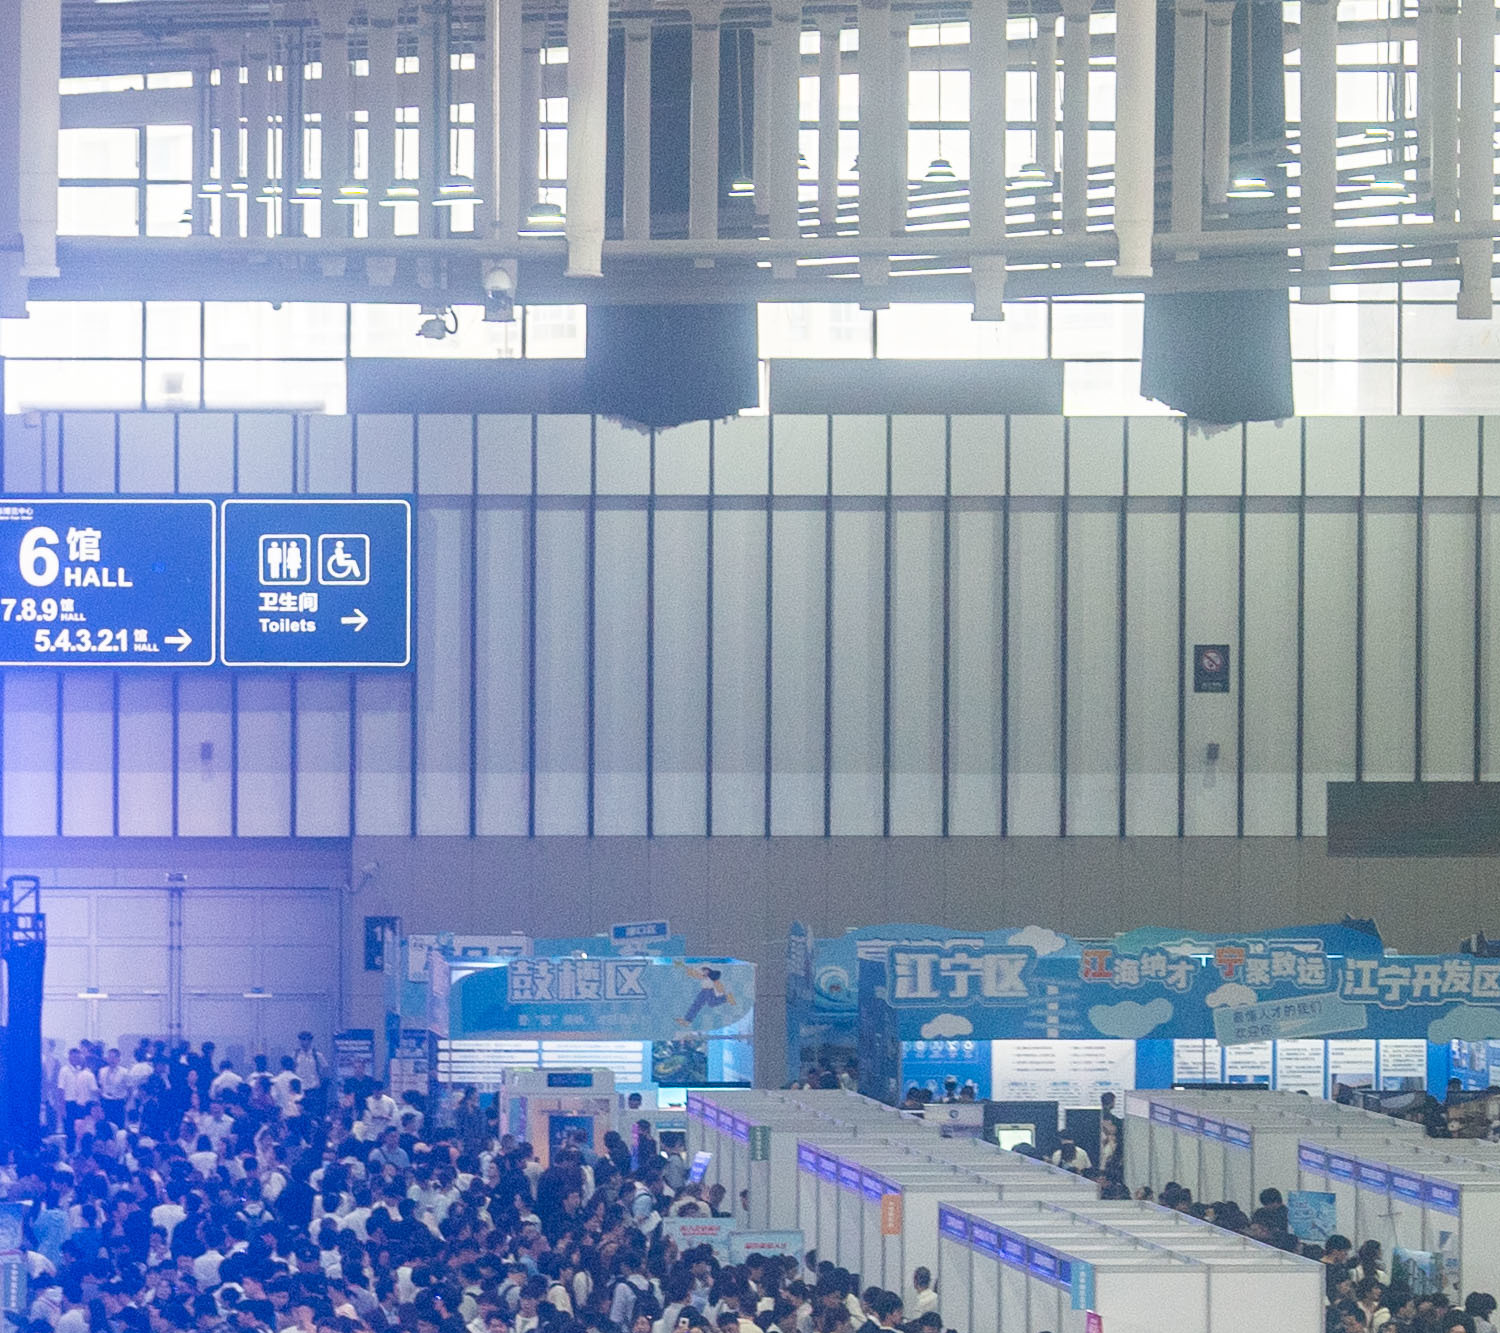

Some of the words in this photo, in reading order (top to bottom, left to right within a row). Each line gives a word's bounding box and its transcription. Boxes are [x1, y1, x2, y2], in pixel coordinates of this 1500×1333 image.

[19, 526, 60, 588] 6
[66, 527, 102, 562] 馆
[64, 567, 133, 588] HALL
[1, 599, 58, 622] 7.8.9
[60, 599, 75, 612] 馆
[258, 592, 318, 612] 卫生间
[60, 611, 87, 622] HALL
[259, 616, 317, 633] Toilets
[34, 629, 128, 652] 5.4.3.2.1
[133, 642, 160, 652] HALL
[895, 952, 1032, 999] 江宁区
[1083, 948, 1192, 989] 江海纳才
[1215, 947, 1327, 986] 宁聚致远
[510, 959, 649, 1001] 鼓楼区
